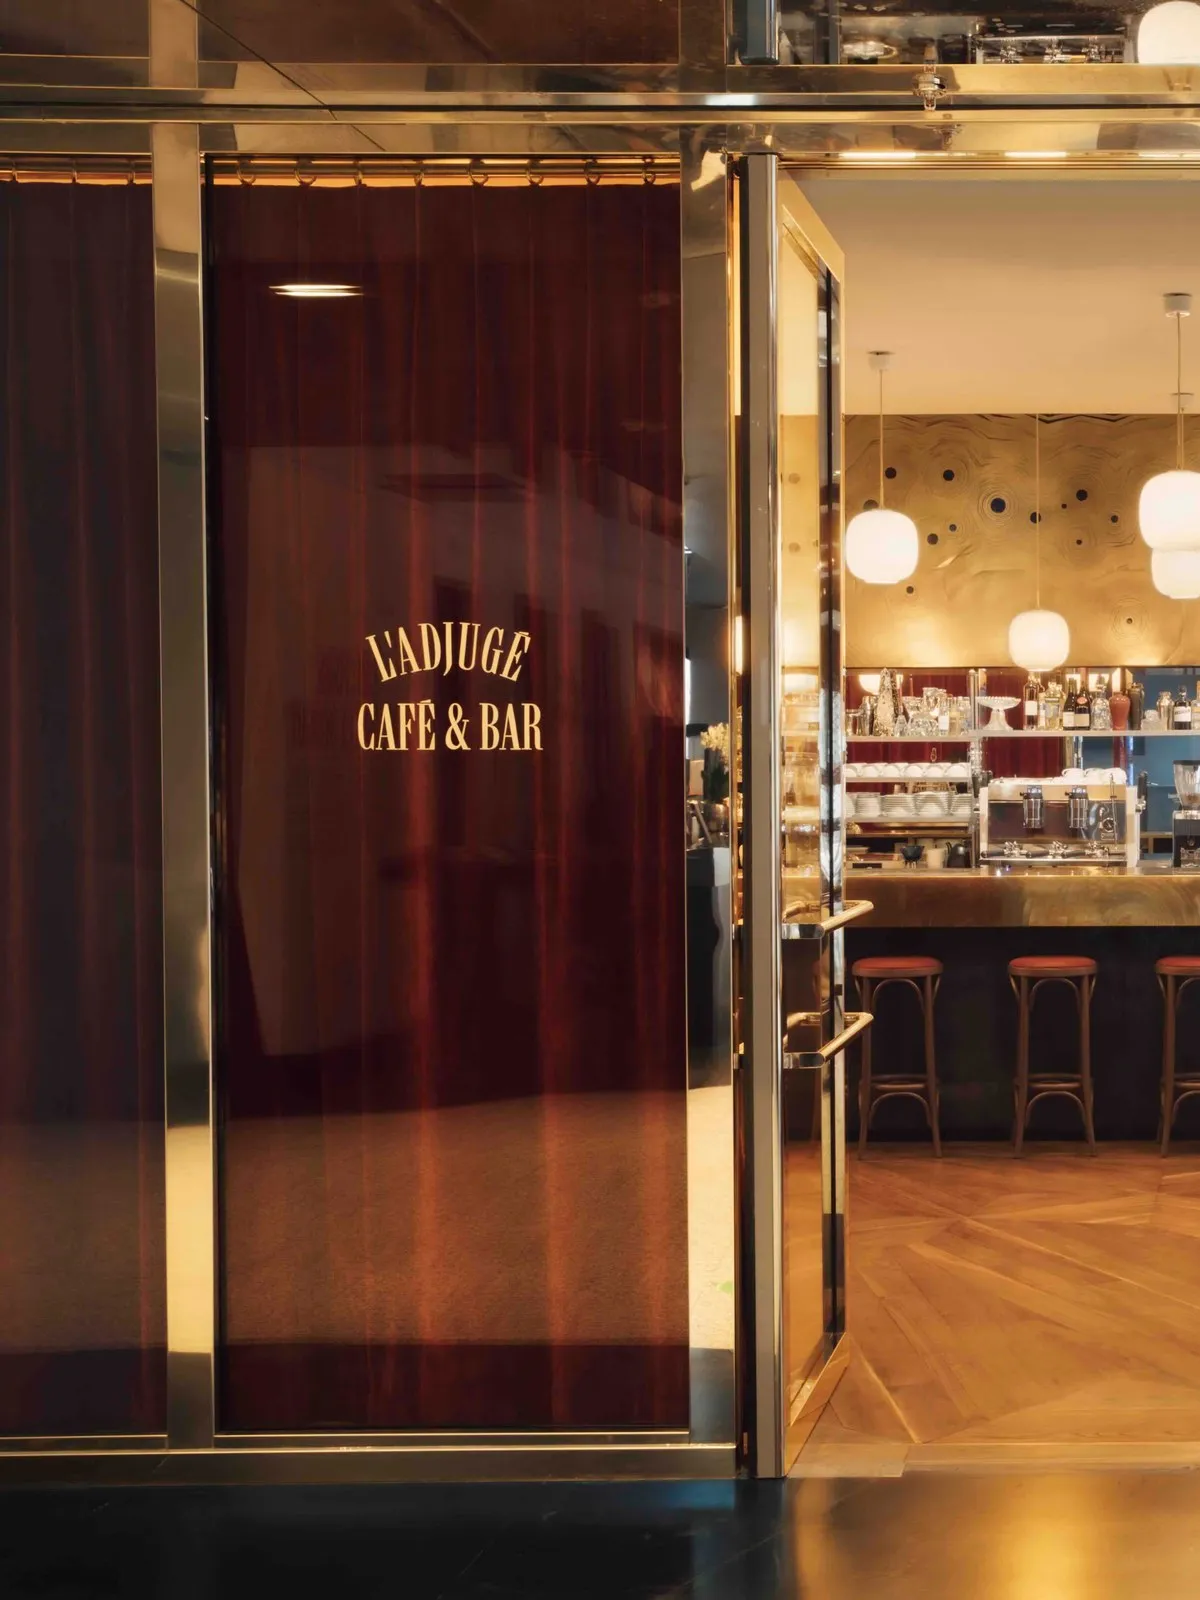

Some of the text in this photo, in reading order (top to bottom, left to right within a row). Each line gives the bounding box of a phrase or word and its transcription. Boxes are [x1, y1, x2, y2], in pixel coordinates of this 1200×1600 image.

[366, 622, 531, 682] L'ADJUGÉ
[357, 699, 543, 750] CAFÉ & BAR
